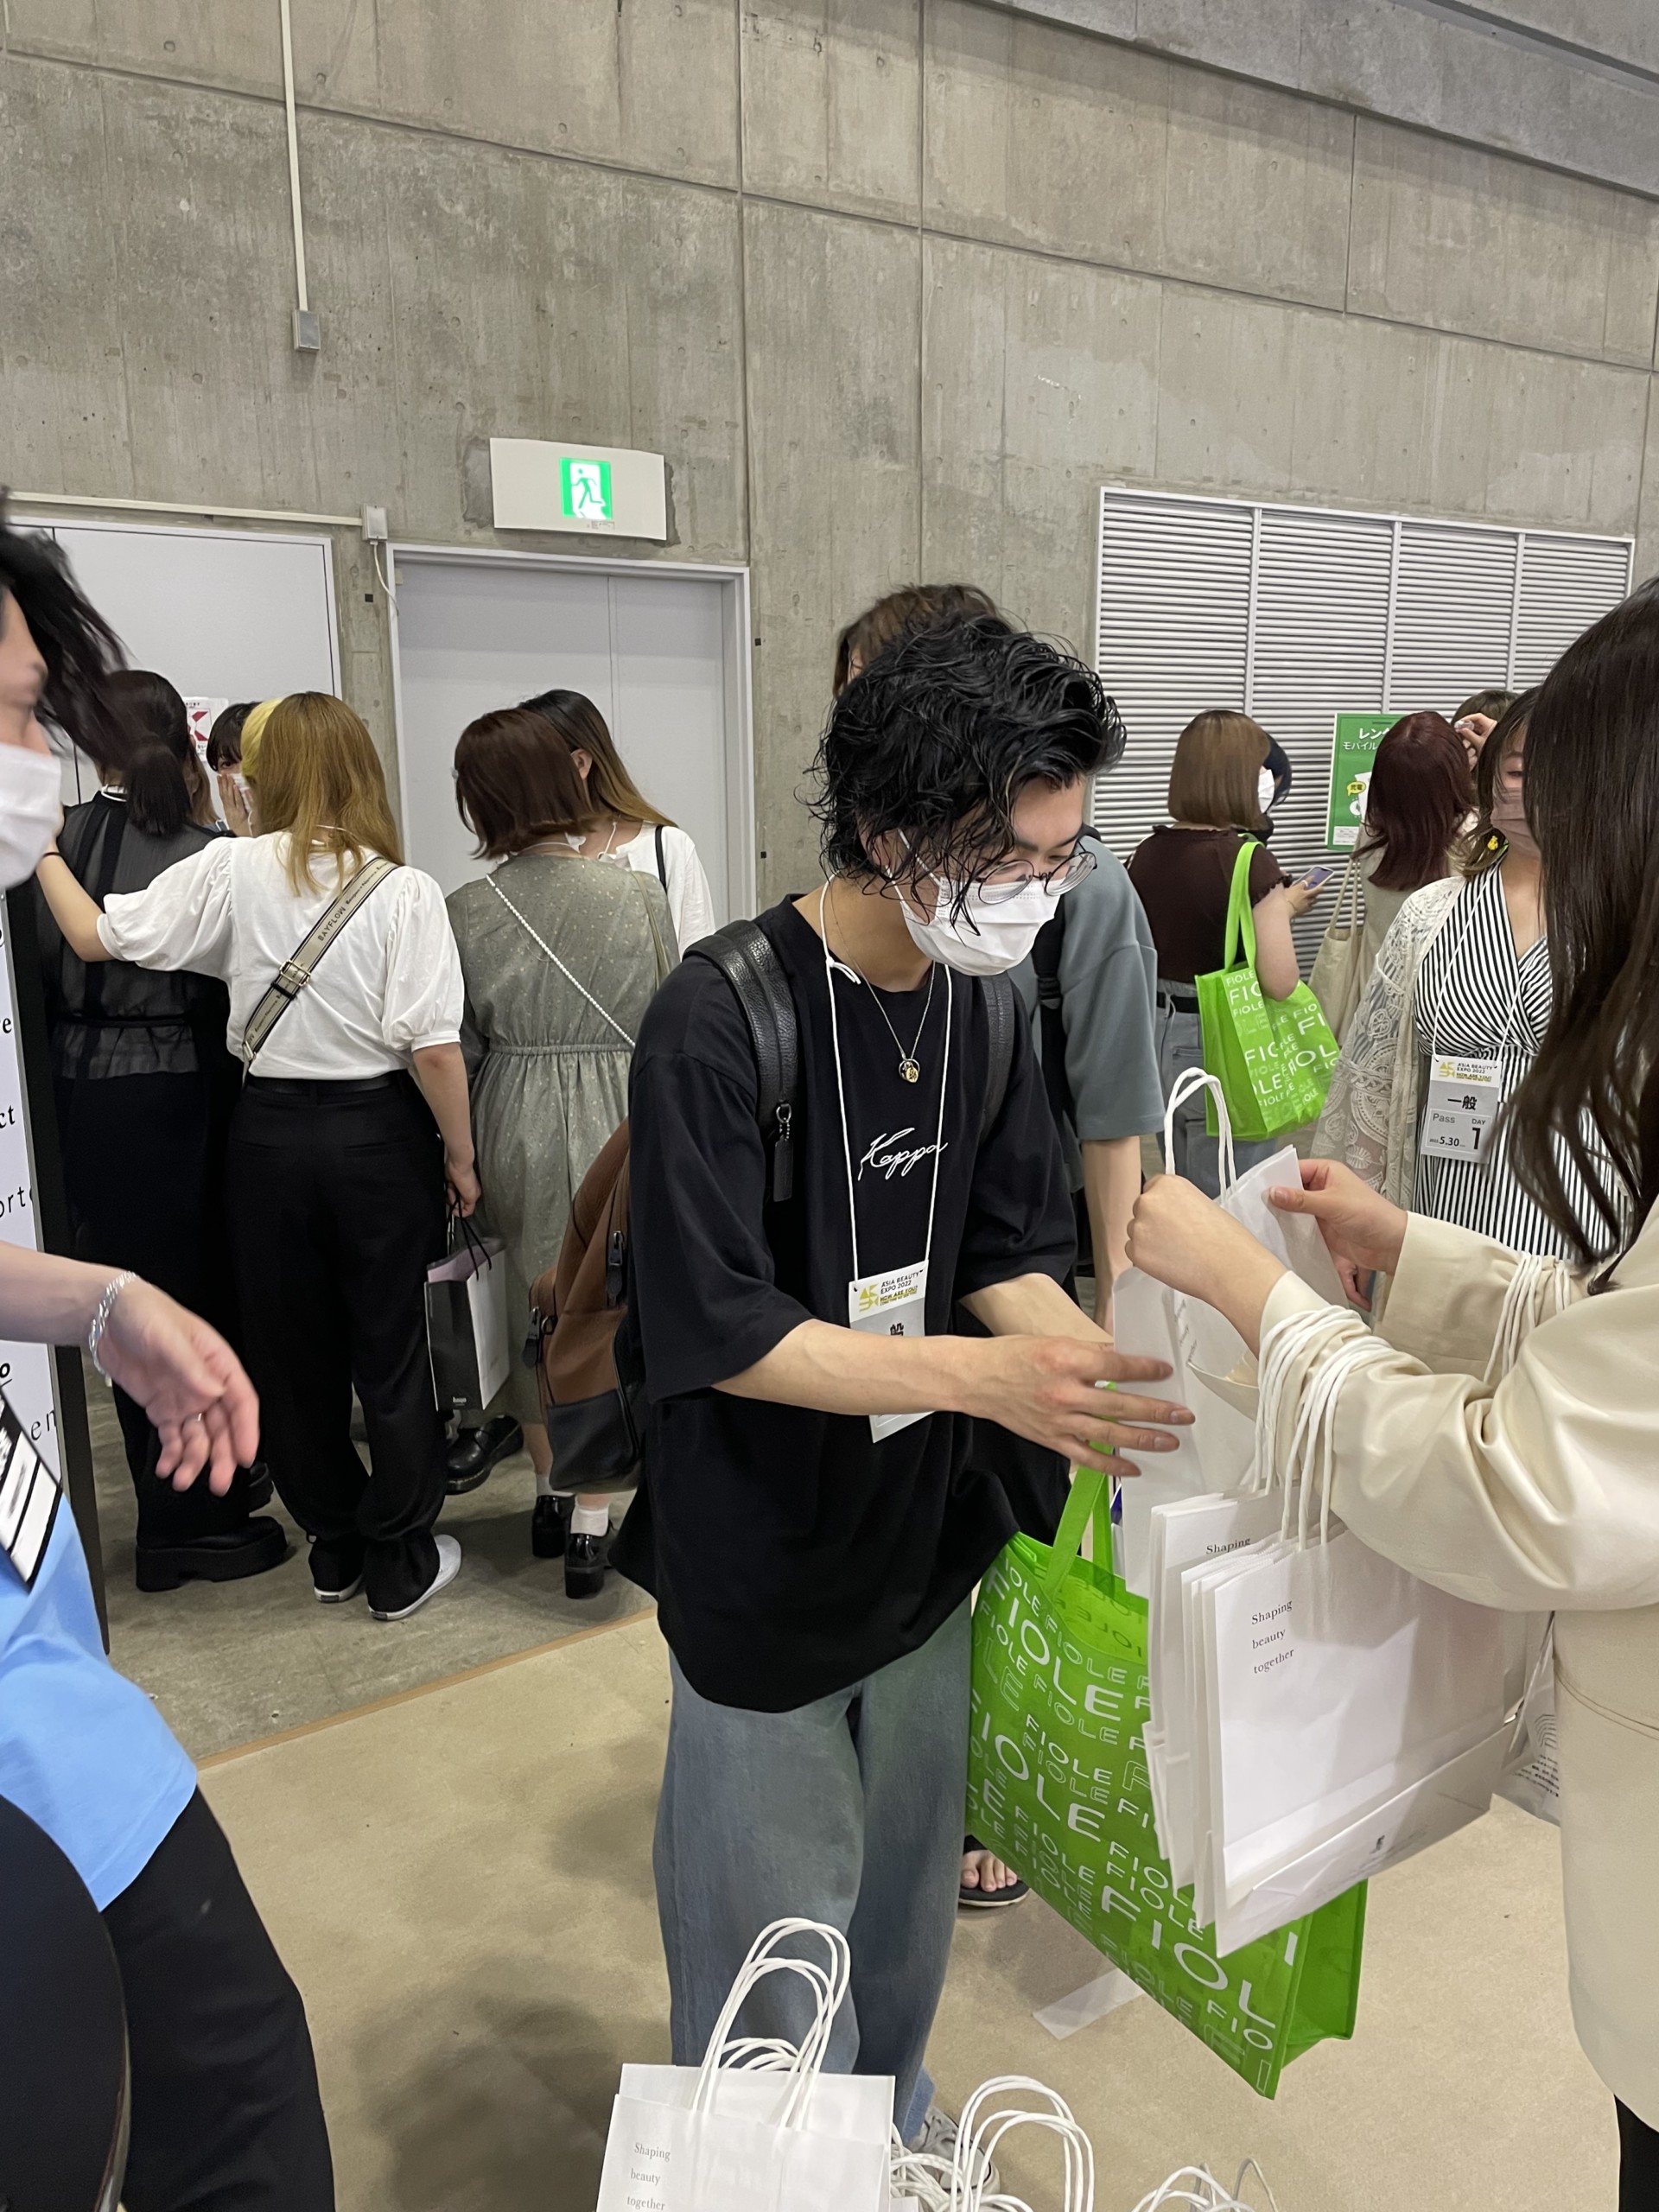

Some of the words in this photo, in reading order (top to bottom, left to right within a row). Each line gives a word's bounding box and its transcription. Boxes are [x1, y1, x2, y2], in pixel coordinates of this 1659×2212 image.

[1343, 741, 1378, 750] モバイル
[317, 906, 346, 942] BAYFLOW
[1447, 1095, 1478, 1110] 一般
[1433, 1113, 1456, 1124] Pass
[1471, 1127, 1481, 1150] 1
[858, 1127, 948, 1181] Kappa
[896, 1272, 919, 1282] BEAUTY
[1206, 1537, 1251, 1554] Shaping
[1251, 1600, 1293, 1625] Shaping
[1045, 1614, 1128, 1685] FIOLE
[1251, 1629, 1286, 1649] beauty
[1253, 1649, 1294, 1674] together
[1033, 1674, 1120, 1745] FIOLE
[1026, 1713, 1113, 1785] FIOLE
[1022, 1732, 1110, 1805] FIOLE
[1015, 1805, 1096, 1885] FIOLE
[633, 2142, 671, 2163] Shaping
[631, 2167, 661, 2186] beauty
[626, 2196, 665, 2211] together
